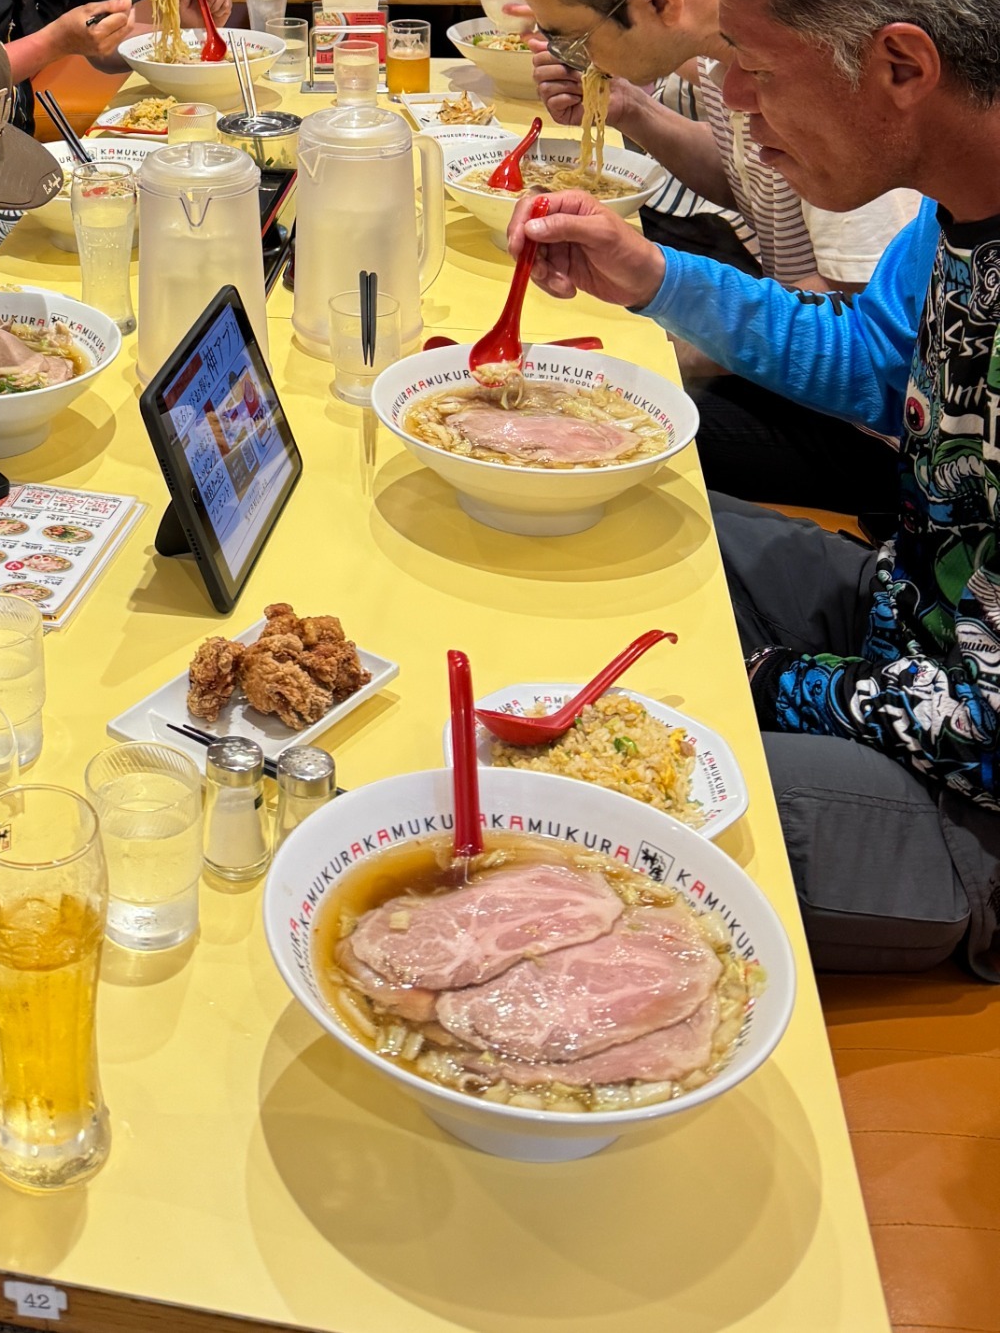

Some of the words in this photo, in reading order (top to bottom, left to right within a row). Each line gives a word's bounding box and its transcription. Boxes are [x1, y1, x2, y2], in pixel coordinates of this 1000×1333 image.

[411, 369, 471, 394] KAMUKUR
[524, 362, 604, 383] AMUKURA
[491, 813, 630, 864] KAMUKURA
[23, 1292, 51, 1310] 42
